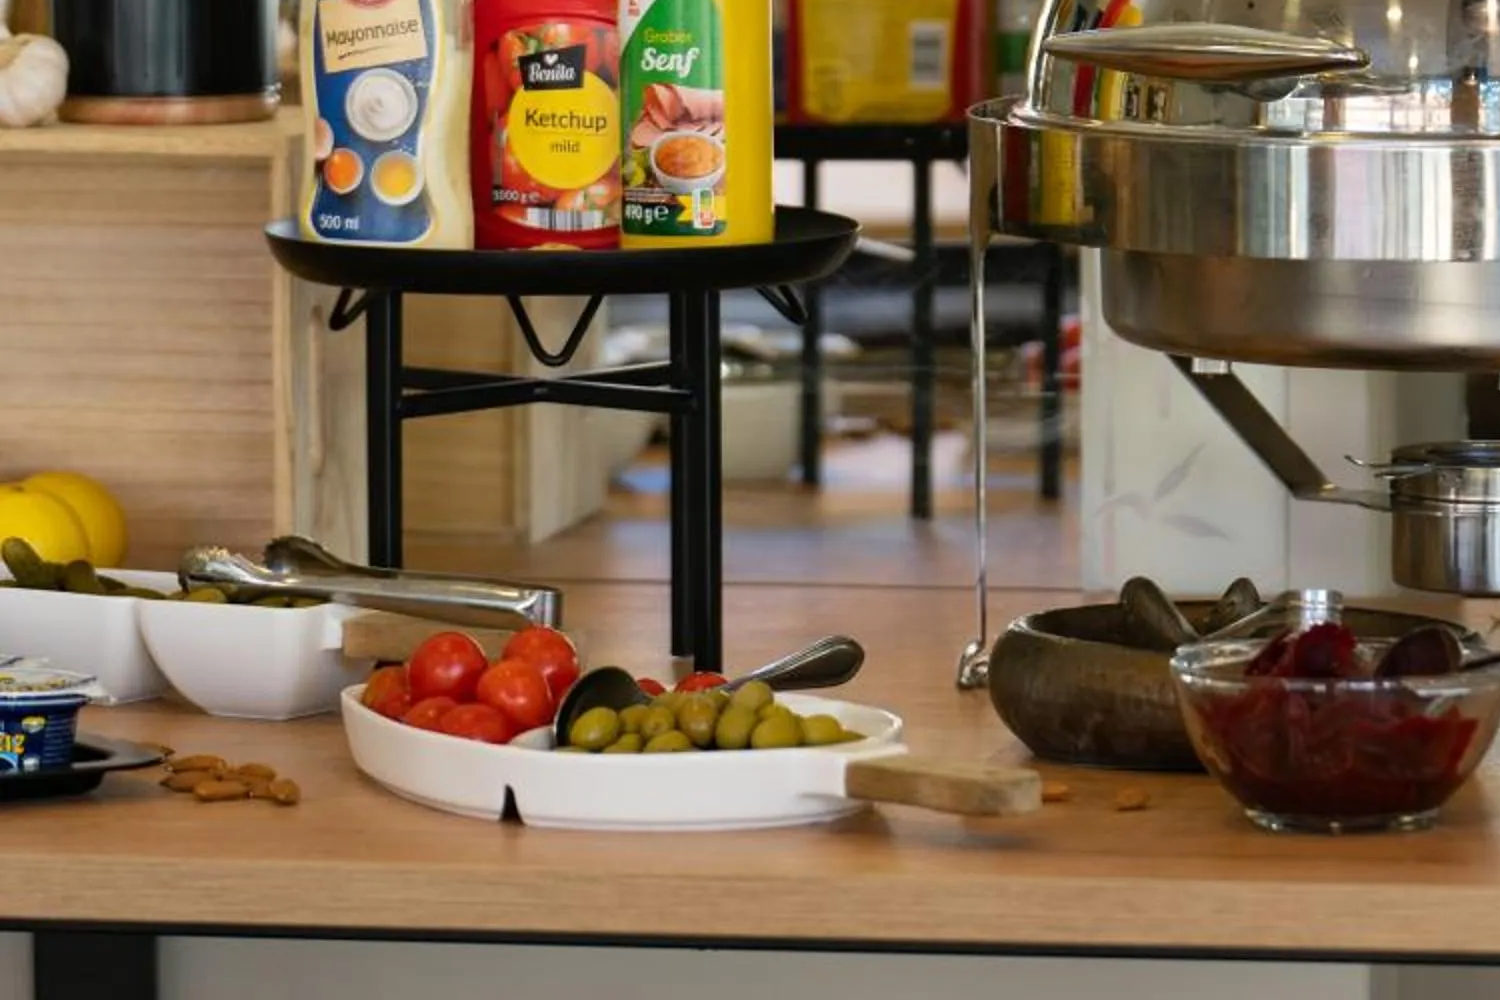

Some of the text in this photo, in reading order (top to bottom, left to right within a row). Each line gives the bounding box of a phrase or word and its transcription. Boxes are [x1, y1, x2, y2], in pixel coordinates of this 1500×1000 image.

[326, 18, 419, 48] Mayonnaise
[641, 47, 700, 78] Senf
[524, 108, 608, 132] Ketchup
[550, 140, 581, 154] mild
